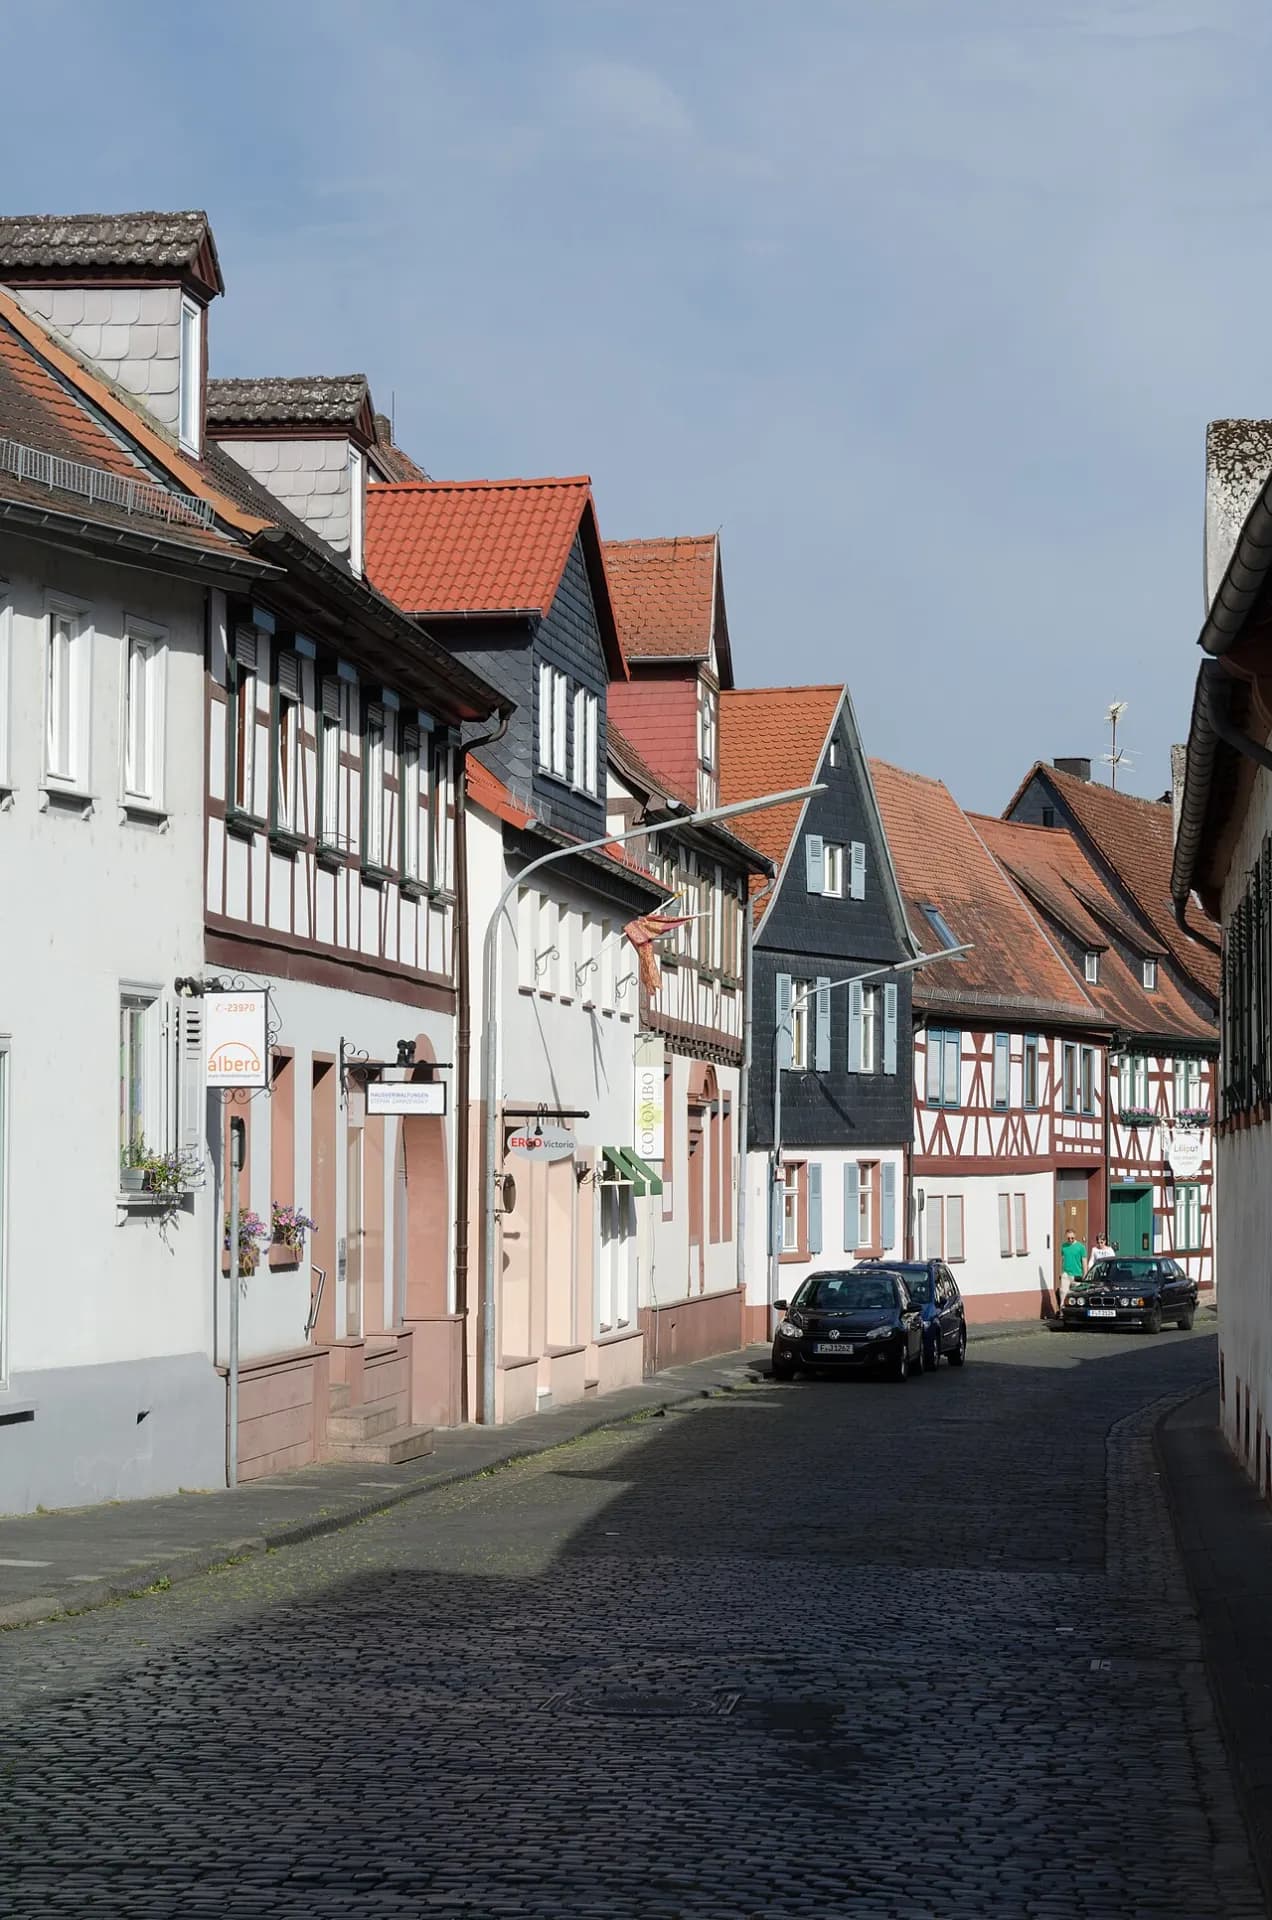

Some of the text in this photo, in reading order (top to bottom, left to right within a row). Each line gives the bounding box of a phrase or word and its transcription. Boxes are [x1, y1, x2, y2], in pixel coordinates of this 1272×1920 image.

[208, 1056, 261, 1072] albero
[641, 1072, 655, 1155] COLOMBO
[511, 1138, 574, 1149] ERGO Victoria
